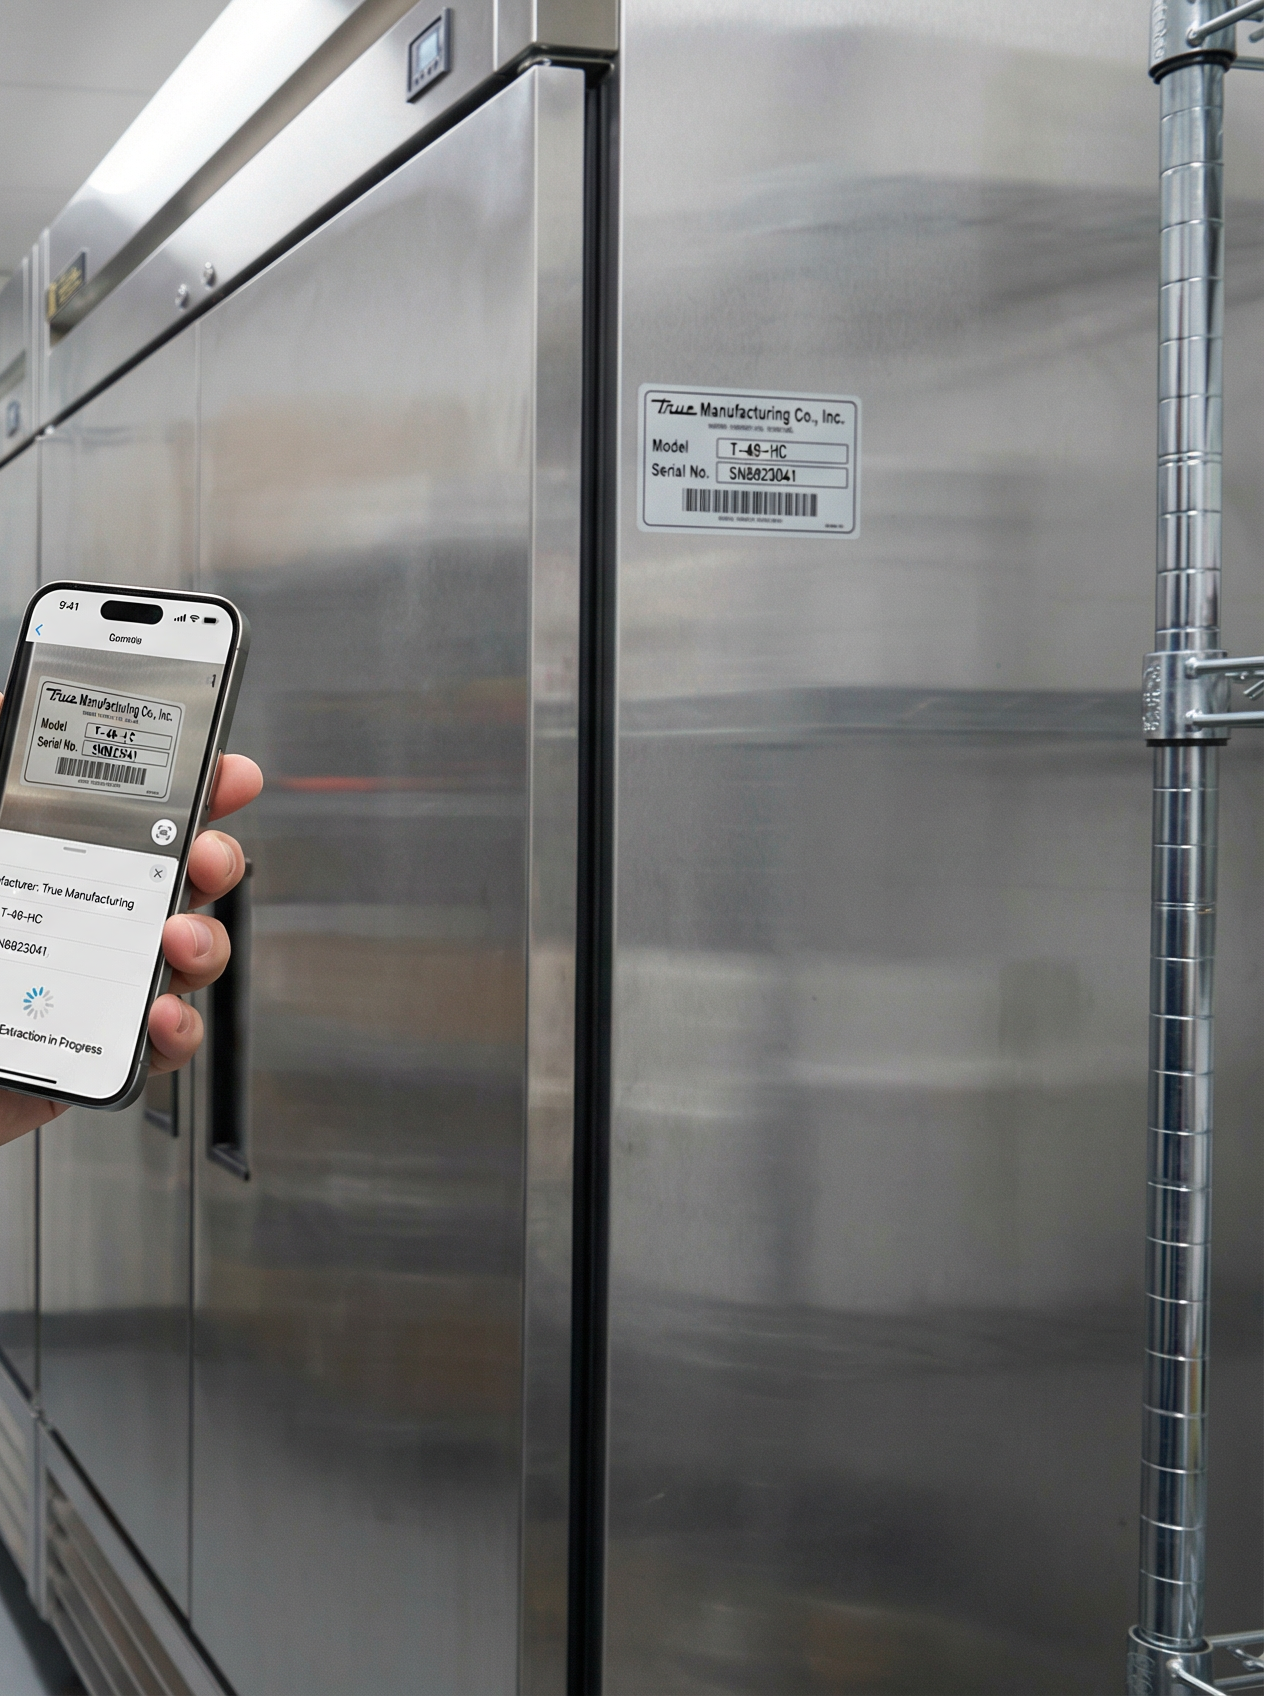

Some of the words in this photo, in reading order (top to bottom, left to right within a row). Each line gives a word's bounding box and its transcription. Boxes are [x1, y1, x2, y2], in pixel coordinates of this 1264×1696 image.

[651, 398, 697, 415] True
[700, 402, 791, 426] Manufacturing
[822, 409, 846, 425] Inc.
[652, 438, 689, 454] Model
[651, 462, 686, 478] Serial
[689, 464, 710, 479] No.
[40, 717, 68, 732] Model
[37, 735, 63, 749] Serial
[42, 882, 63, 896] True
[64, 887, 135, 911] Manufacturing
[48, 1034, 58, 1046] in
[58, 1036, 103, 1055] Progress
